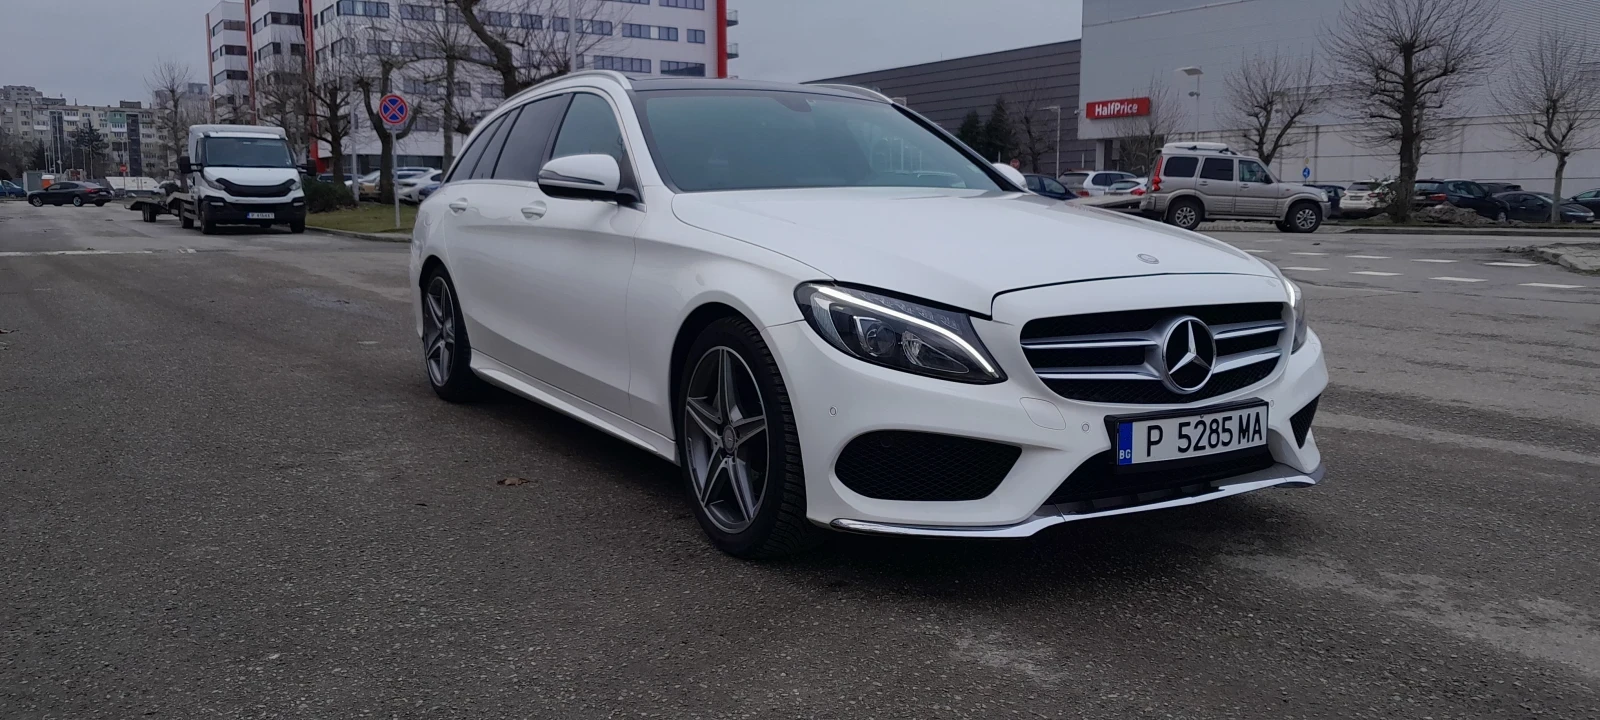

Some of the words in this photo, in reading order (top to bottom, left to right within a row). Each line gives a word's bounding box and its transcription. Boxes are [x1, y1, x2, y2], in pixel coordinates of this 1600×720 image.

[1095, 102, 1138, 116] HalfPrice
[1146, 425, 1163, 457] P
[1177, 416, 1234, 454] 5285
[1237, 411, 1263, 445] MA
[1119, 449, 1131, 459] BG
